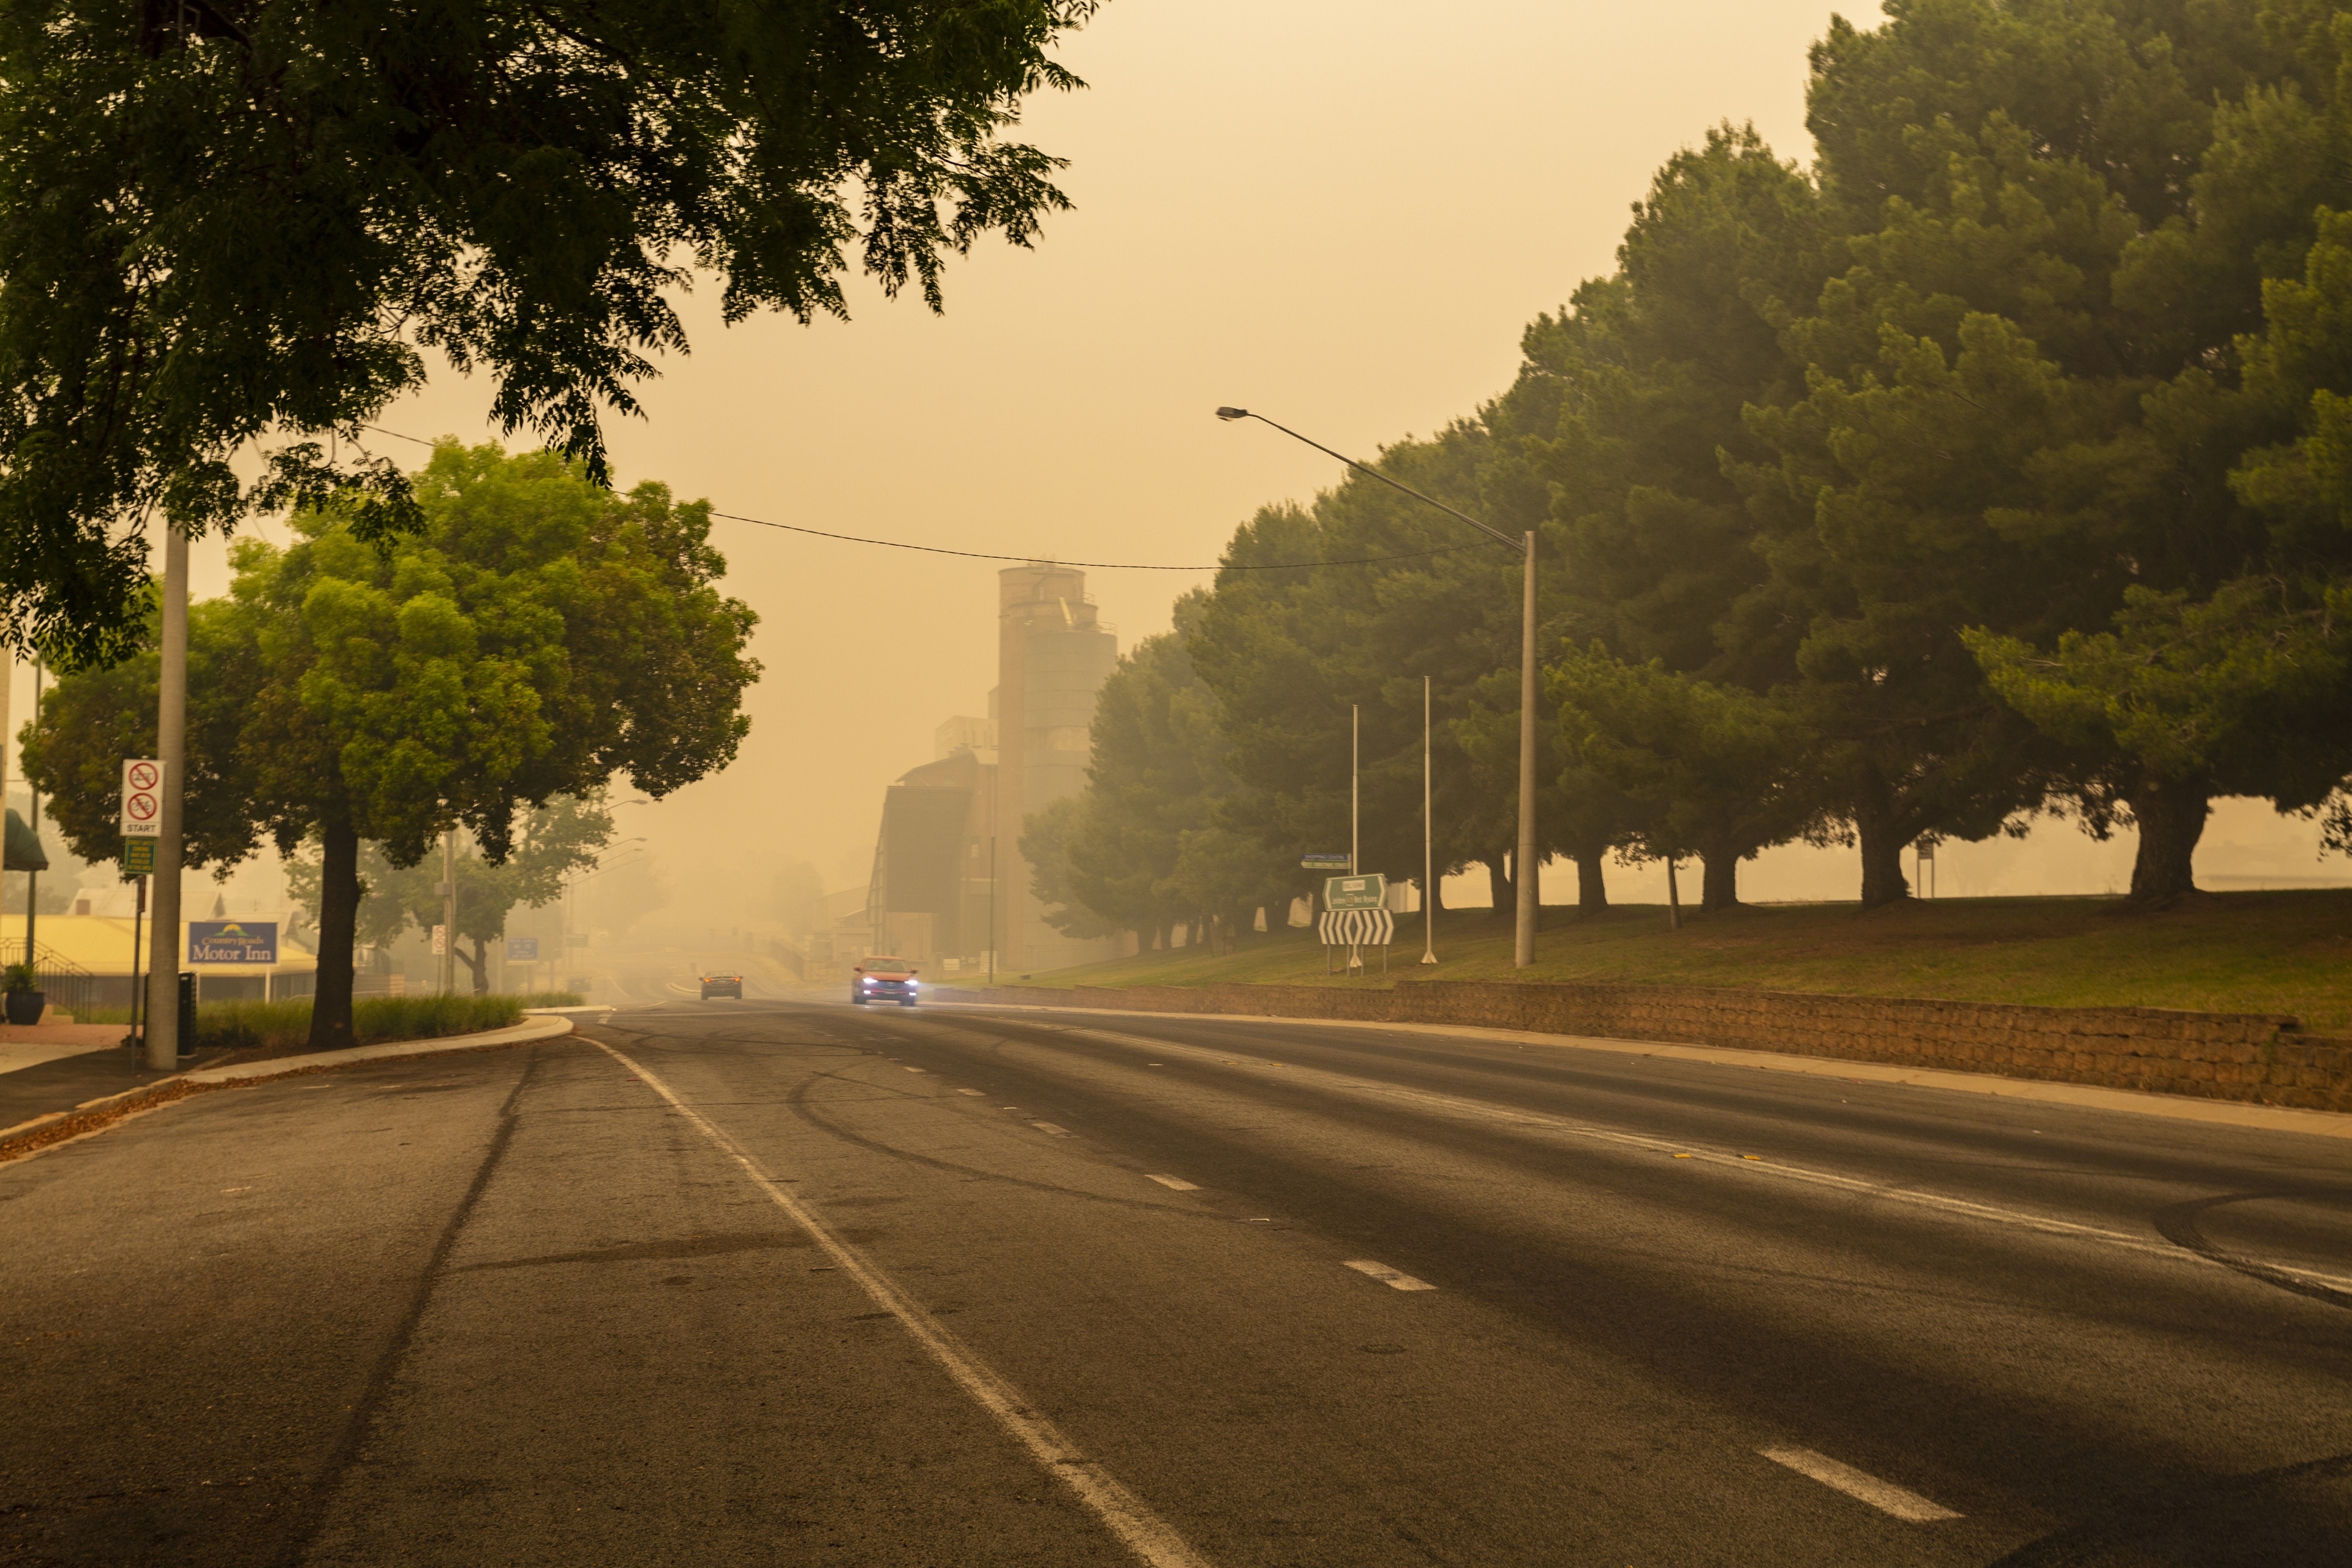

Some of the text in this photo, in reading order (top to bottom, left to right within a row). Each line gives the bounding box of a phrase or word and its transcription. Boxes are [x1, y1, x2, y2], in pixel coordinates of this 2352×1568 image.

[202, 935, 265, 946] Country Roads
[192, 944, 271, 961] Motor Inn
